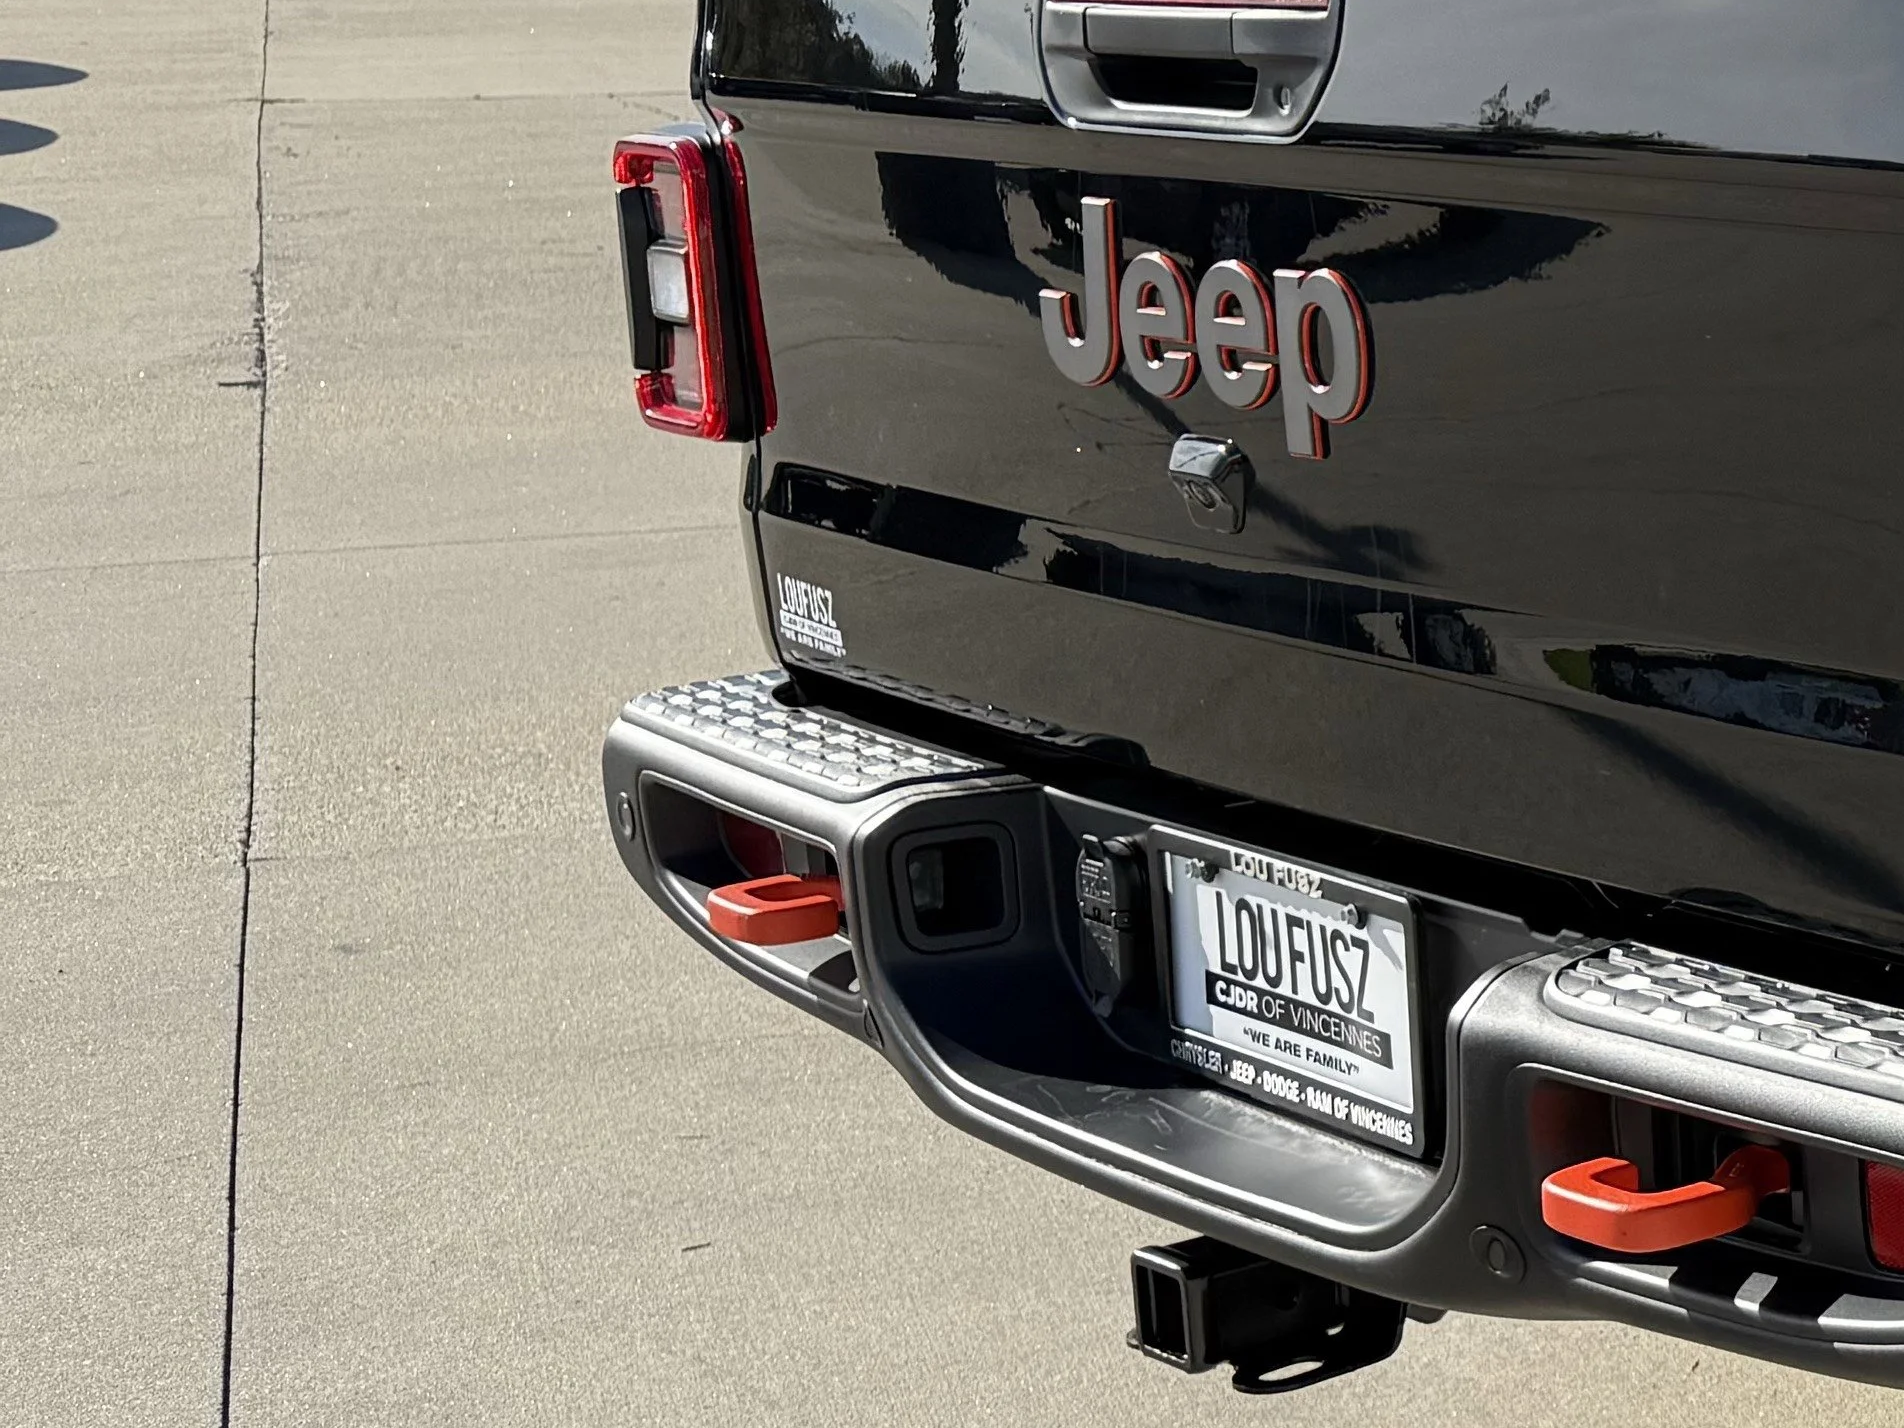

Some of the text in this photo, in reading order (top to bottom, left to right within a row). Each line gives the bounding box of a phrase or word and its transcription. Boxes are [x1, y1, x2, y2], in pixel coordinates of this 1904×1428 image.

[1039, 195, 1375, 459] Jeep
[1229, 850, 1323, 900] LOU FUSZ
[1214, 979, 1383, 1059] CJDR OF VINCENNES
[1274, 1037, 1302, 1059] ARE
[1169, 1037, 1414, 1147] CHRYSLER JEEP DODGE RAM OF VINCENNES
